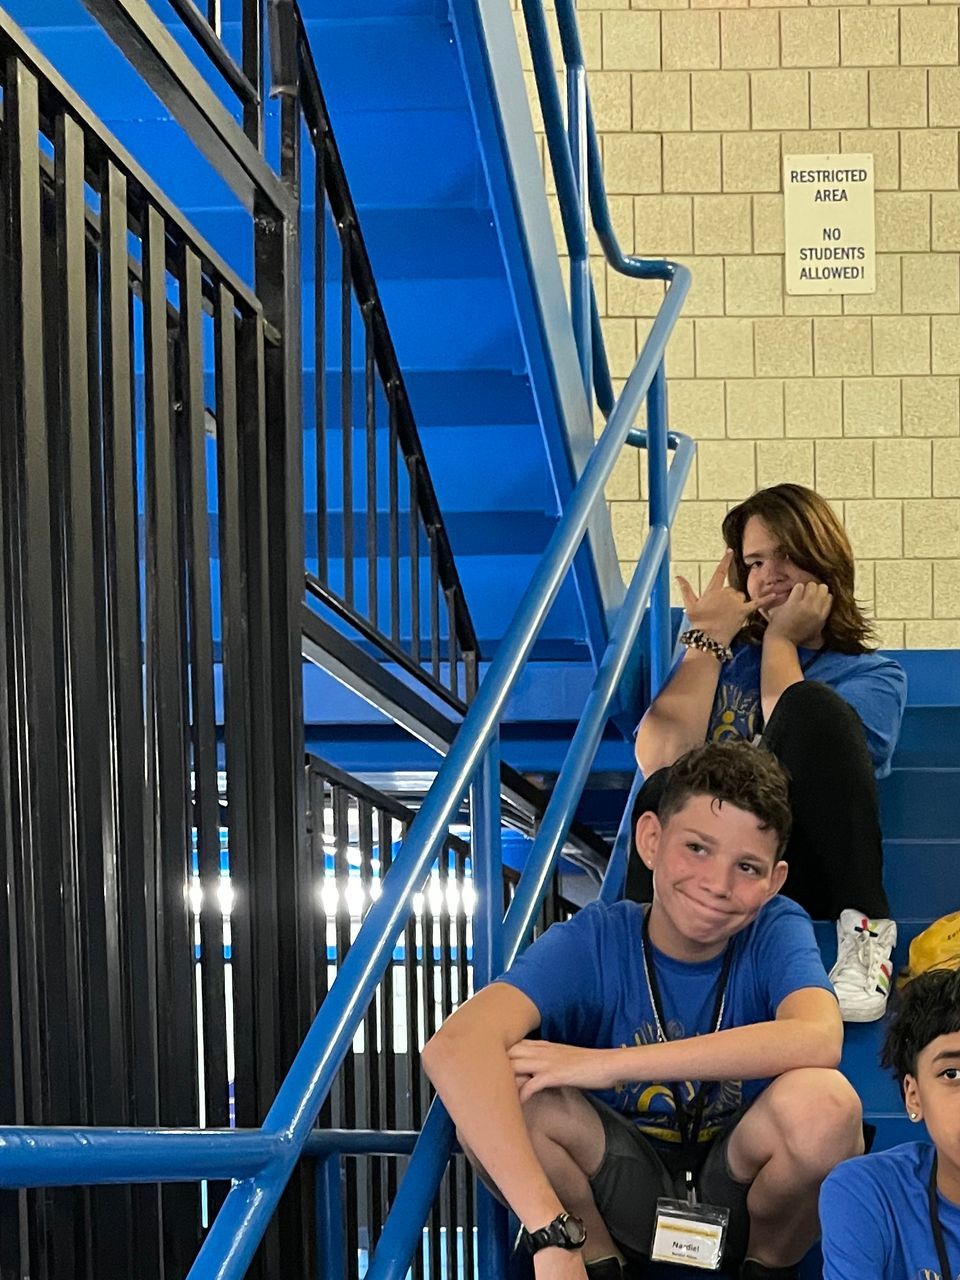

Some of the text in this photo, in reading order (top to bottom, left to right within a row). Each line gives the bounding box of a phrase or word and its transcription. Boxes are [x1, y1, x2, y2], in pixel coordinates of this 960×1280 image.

[790, 169, 867, 183] RESTRICTED
[814, 189, 848, 202] AREA
[822, 227, 842, 241] NO
[800, 246, 865, 260] STUDENTS
[799, 266, 865, 280] ALLOWED!
